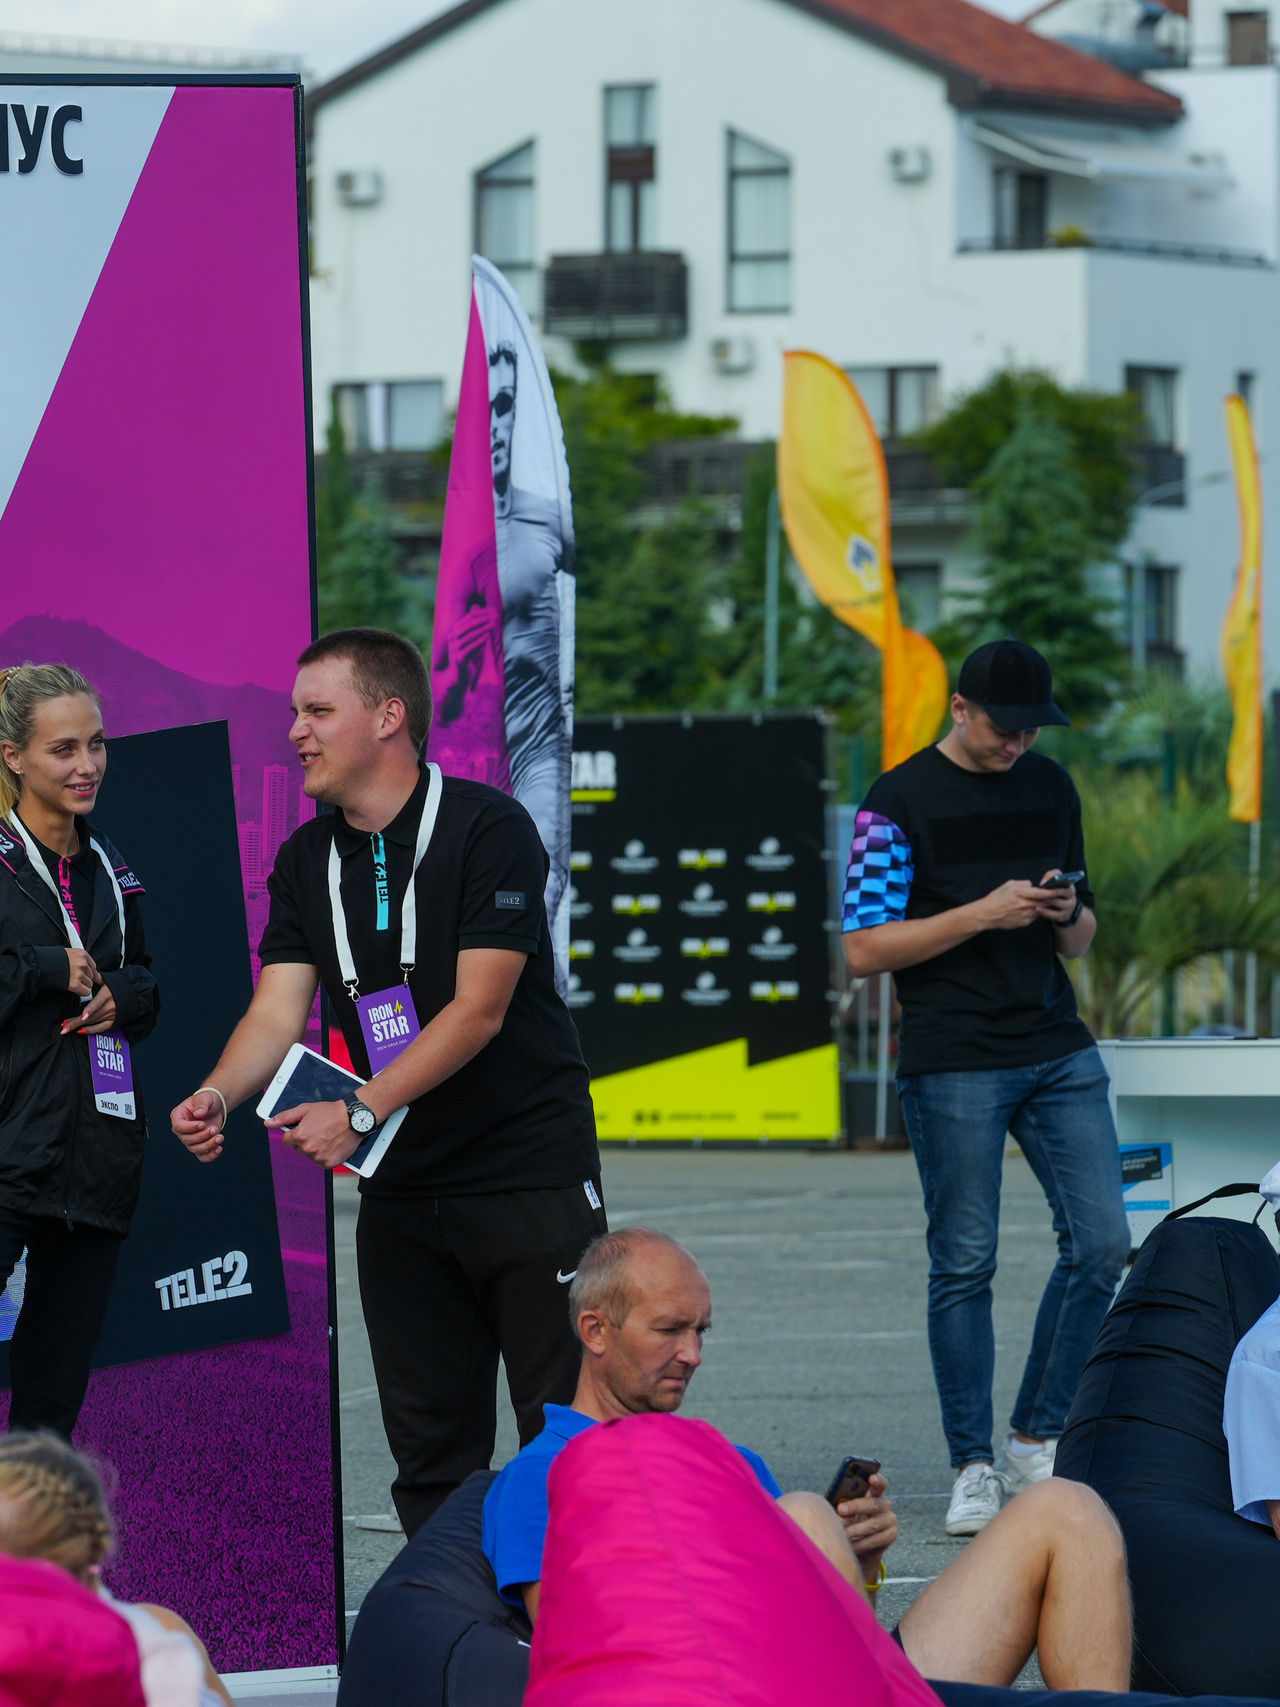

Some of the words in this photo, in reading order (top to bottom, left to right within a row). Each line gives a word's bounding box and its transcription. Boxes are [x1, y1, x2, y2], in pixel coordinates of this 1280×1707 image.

[368, 1003, 394, 1023] IRON
[372, 1016, 410, 1042] STAR
[96, 1034, 114, 1051] IRON
[98, 1050, 124, 1072] STAR
[101, 1100, 118, 1112] ЭКСПО
[155, 1250, 252, 1311] TELE2
